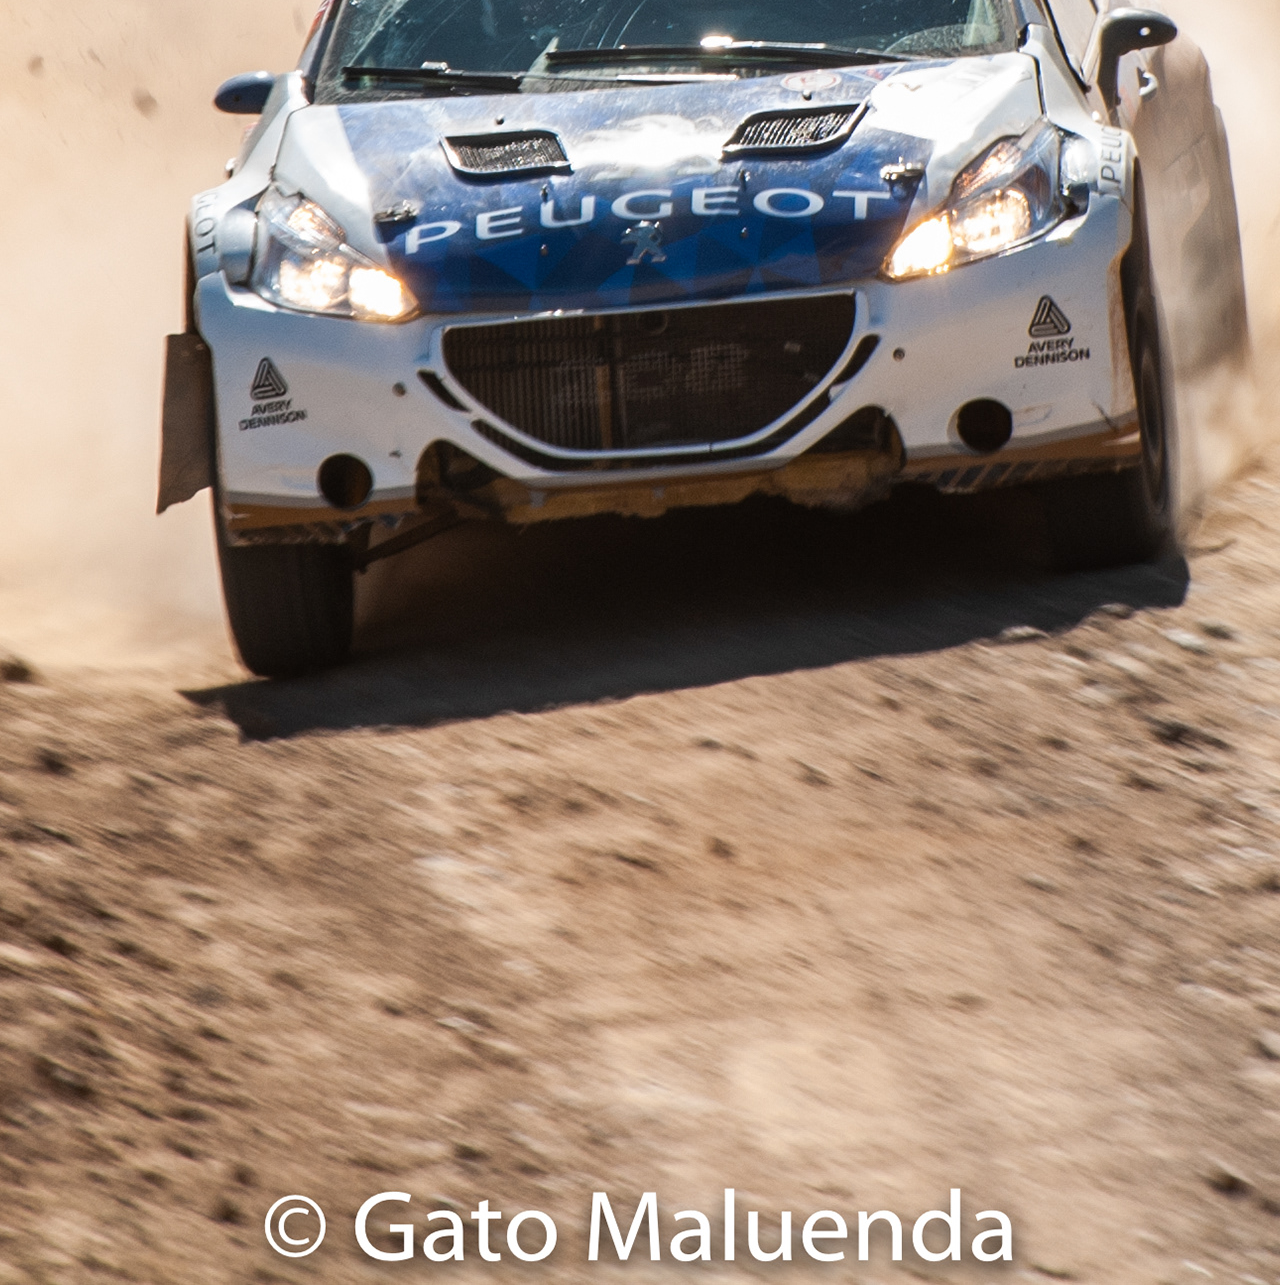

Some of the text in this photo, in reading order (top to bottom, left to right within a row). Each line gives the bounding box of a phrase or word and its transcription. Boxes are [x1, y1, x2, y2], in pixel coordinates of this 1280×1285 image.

[405, 186, 892, 255] PEUGEOT
[1028, 337, 1074, 354] AVERY
[1014, 348, 1090, 369] DENNISON
[251, 398, 293, 417] AVERY
[238, 410, 308, 432] DENNISON
